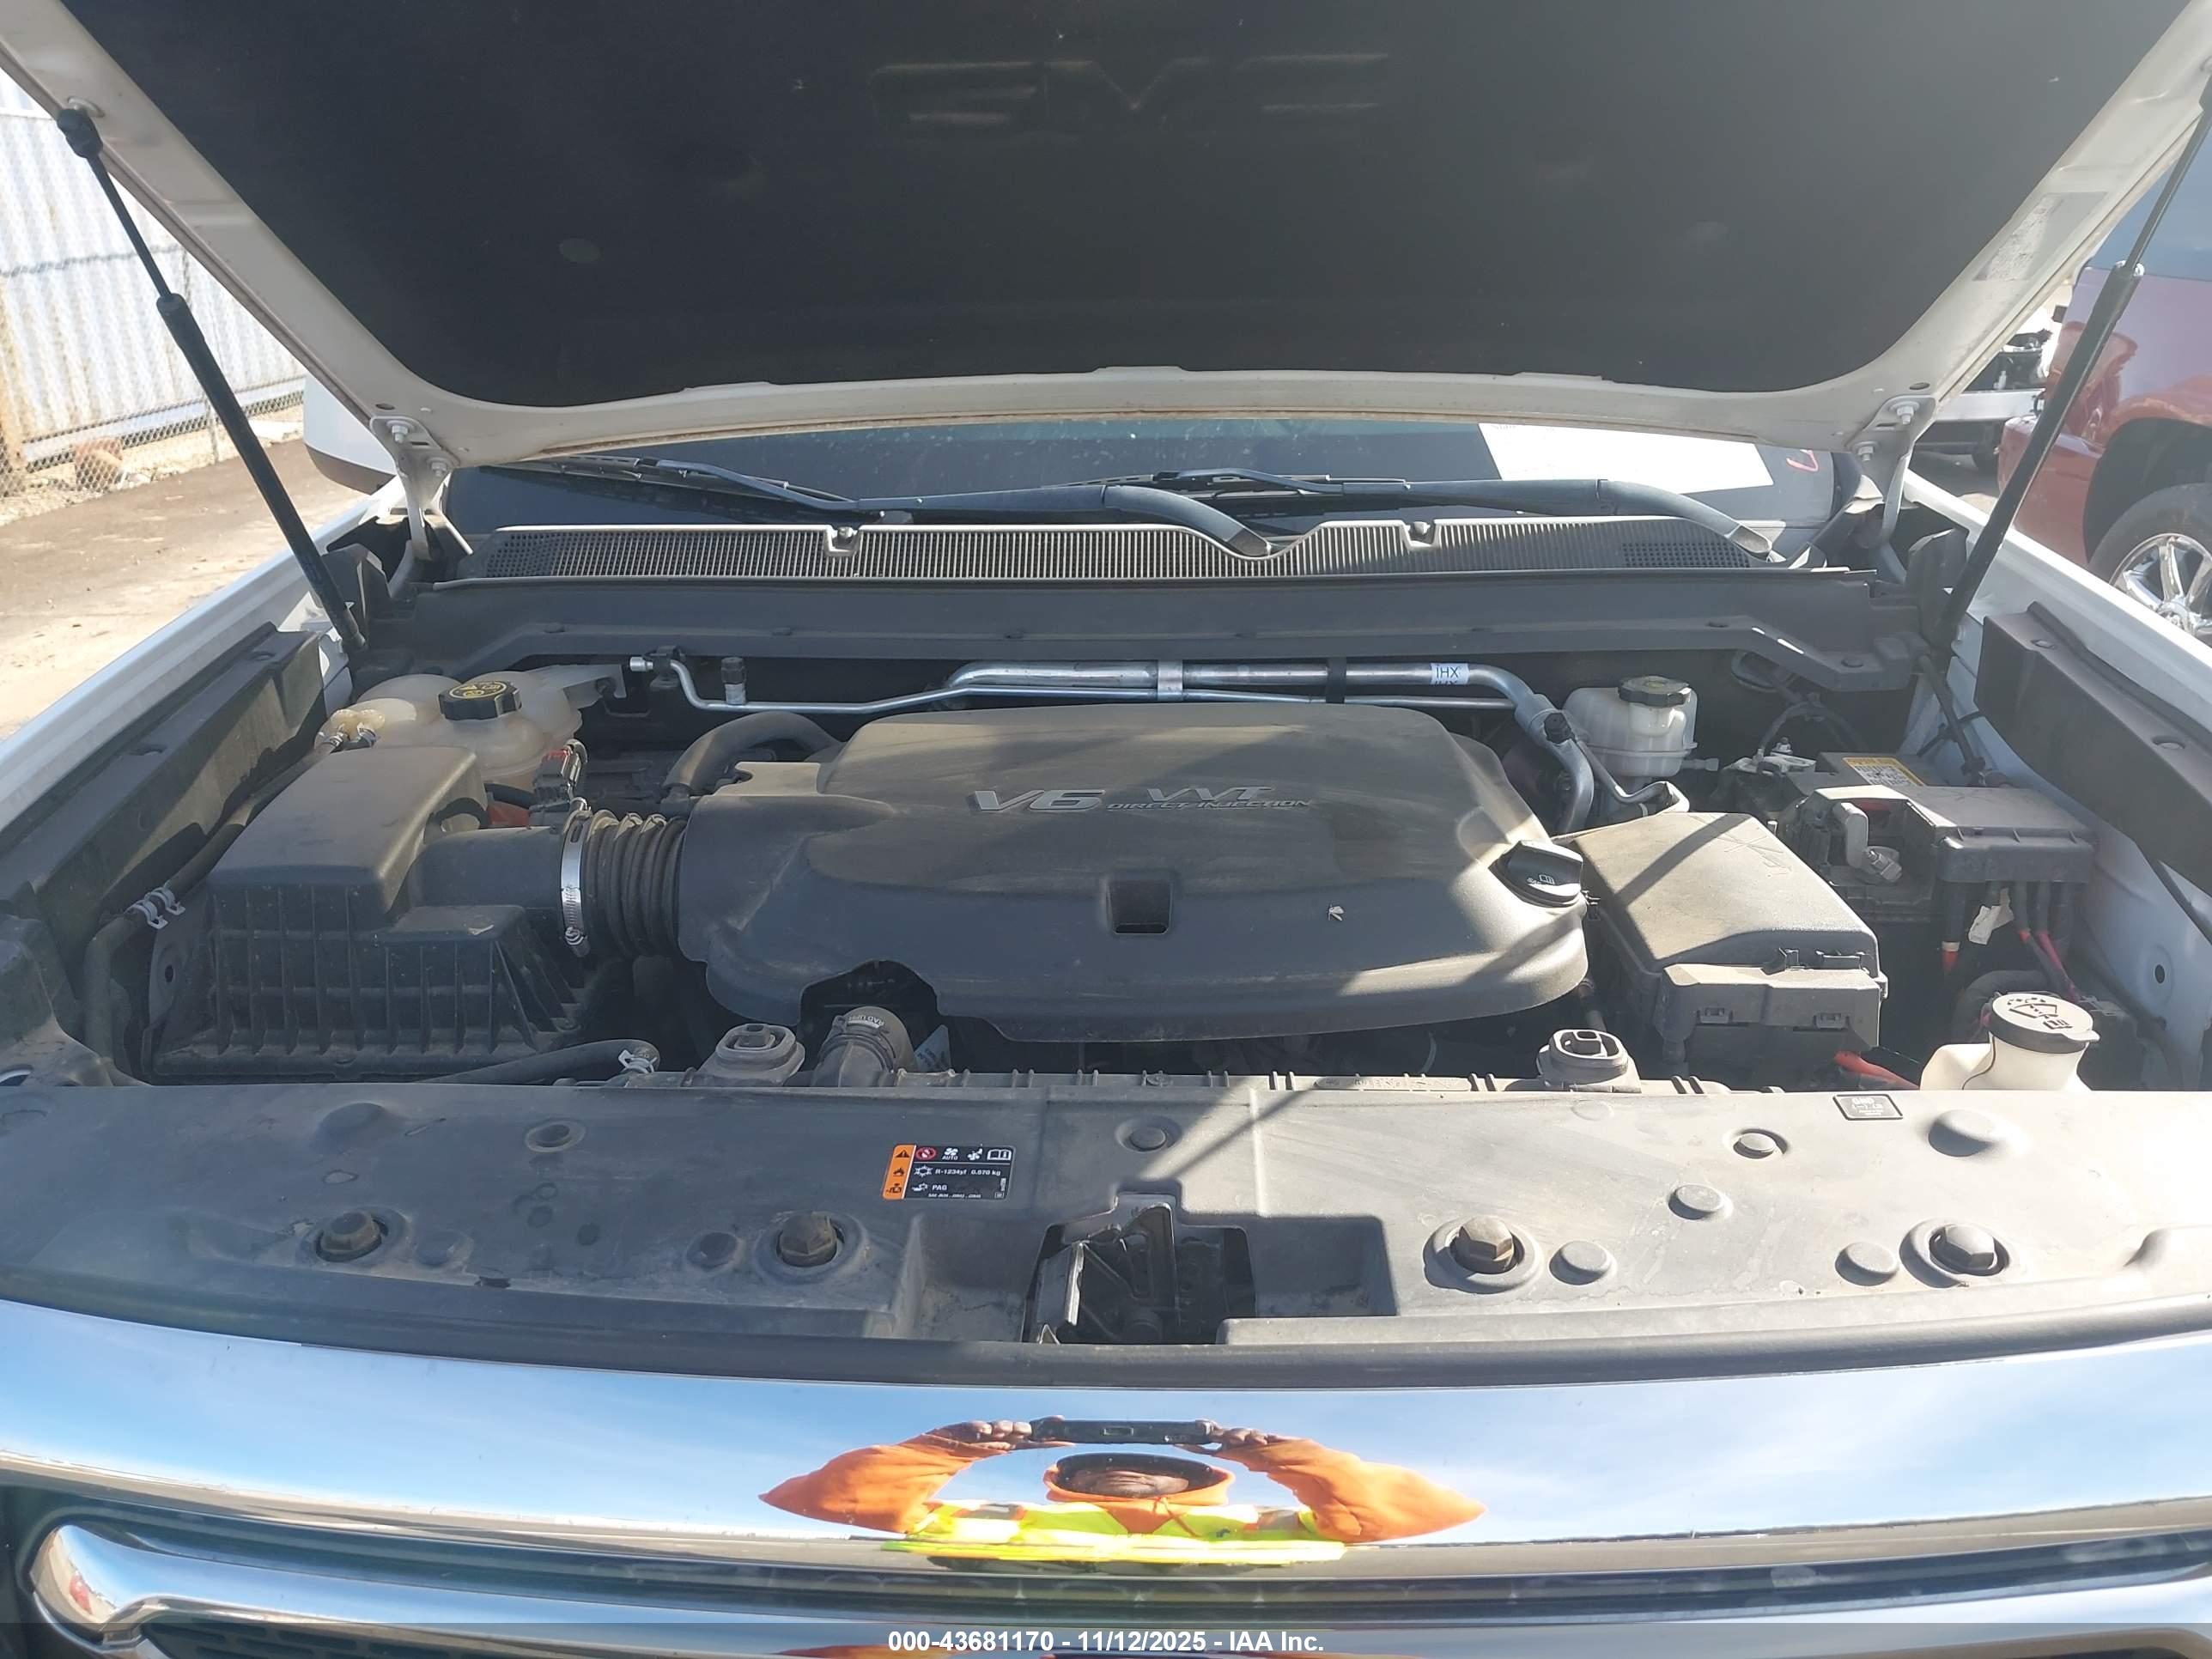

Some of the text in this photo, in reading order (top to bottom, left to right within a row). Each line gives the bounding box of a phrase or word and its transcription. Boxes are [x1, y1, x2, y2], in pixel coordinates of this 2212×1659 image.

[975, 789, 1105, 811] V6
[1147, 786, 1274, 802] VVT
[1107, 799, 1311, 810] DIRECT INJECTION
